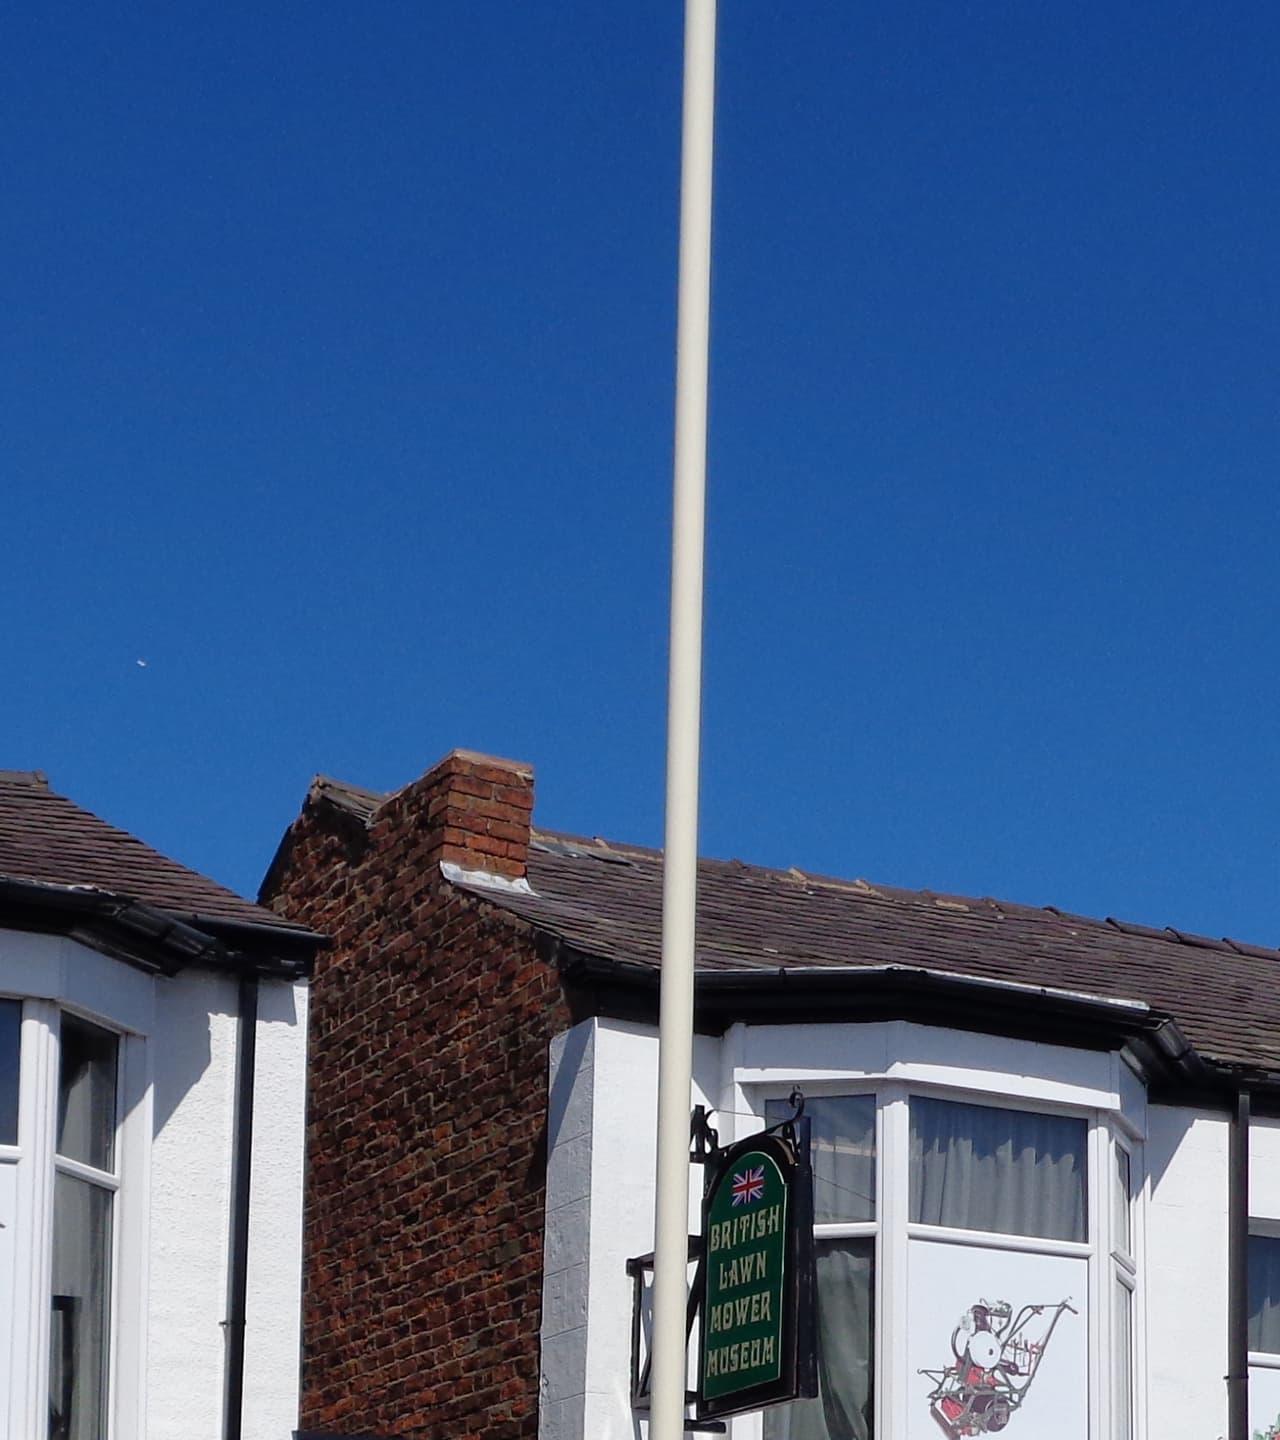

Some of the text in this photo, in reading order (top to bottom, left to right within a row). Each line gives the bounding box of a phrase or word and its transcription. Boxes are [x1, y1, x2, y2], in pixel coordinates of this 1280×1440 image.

[710, 1204, 780, 1251] BRITISH
[719, 1251, 767, 1290] LAWN
[710, 1291, 771, 1334] MOWER
[706, 1336, 774, 1378] MUSEUM
